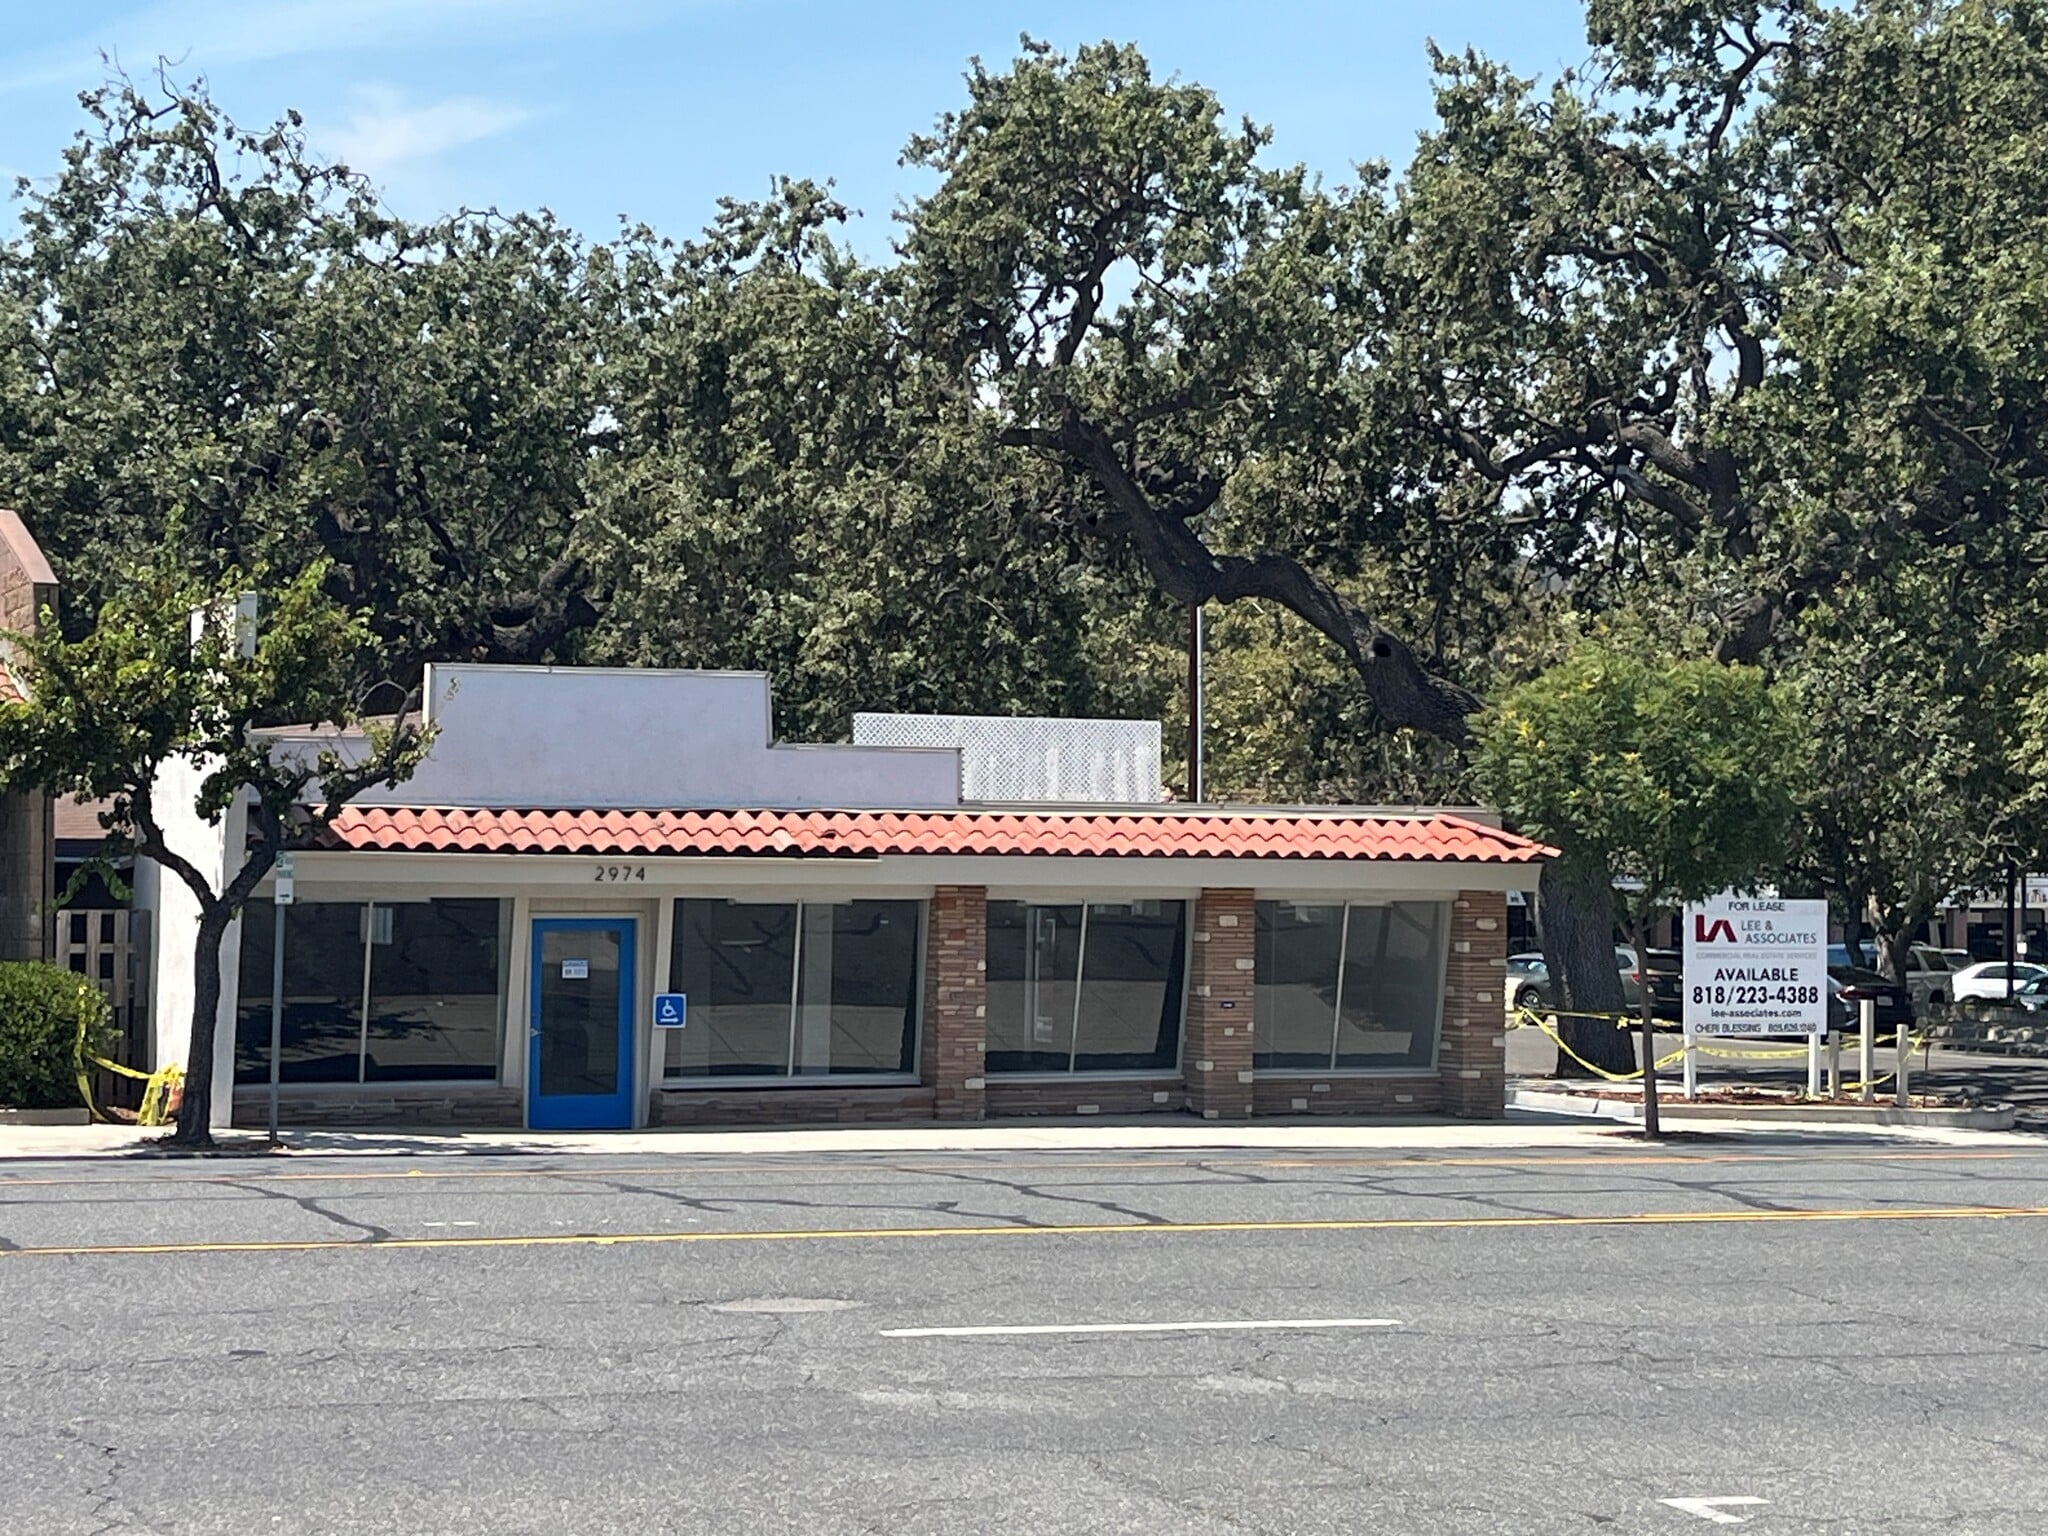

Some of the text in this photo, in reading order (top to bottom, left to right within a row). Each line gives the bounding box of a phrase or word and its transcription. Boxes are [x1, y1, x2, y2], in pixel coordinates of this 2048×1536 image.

[594, 865, 646, 882] 2974
[1728, 901, 1785, 912] FOR LEASE
[1741, 920, 1773, 931] LEE &
[1744, 932, 1817, 944] ASSOCIATES
[1714, 968, 1799, 981] AVAILABLE
[1692, 986, 1819, 1006] 818/223-4388
[1711, 1007, 1802, 1018] lee-associates.com
